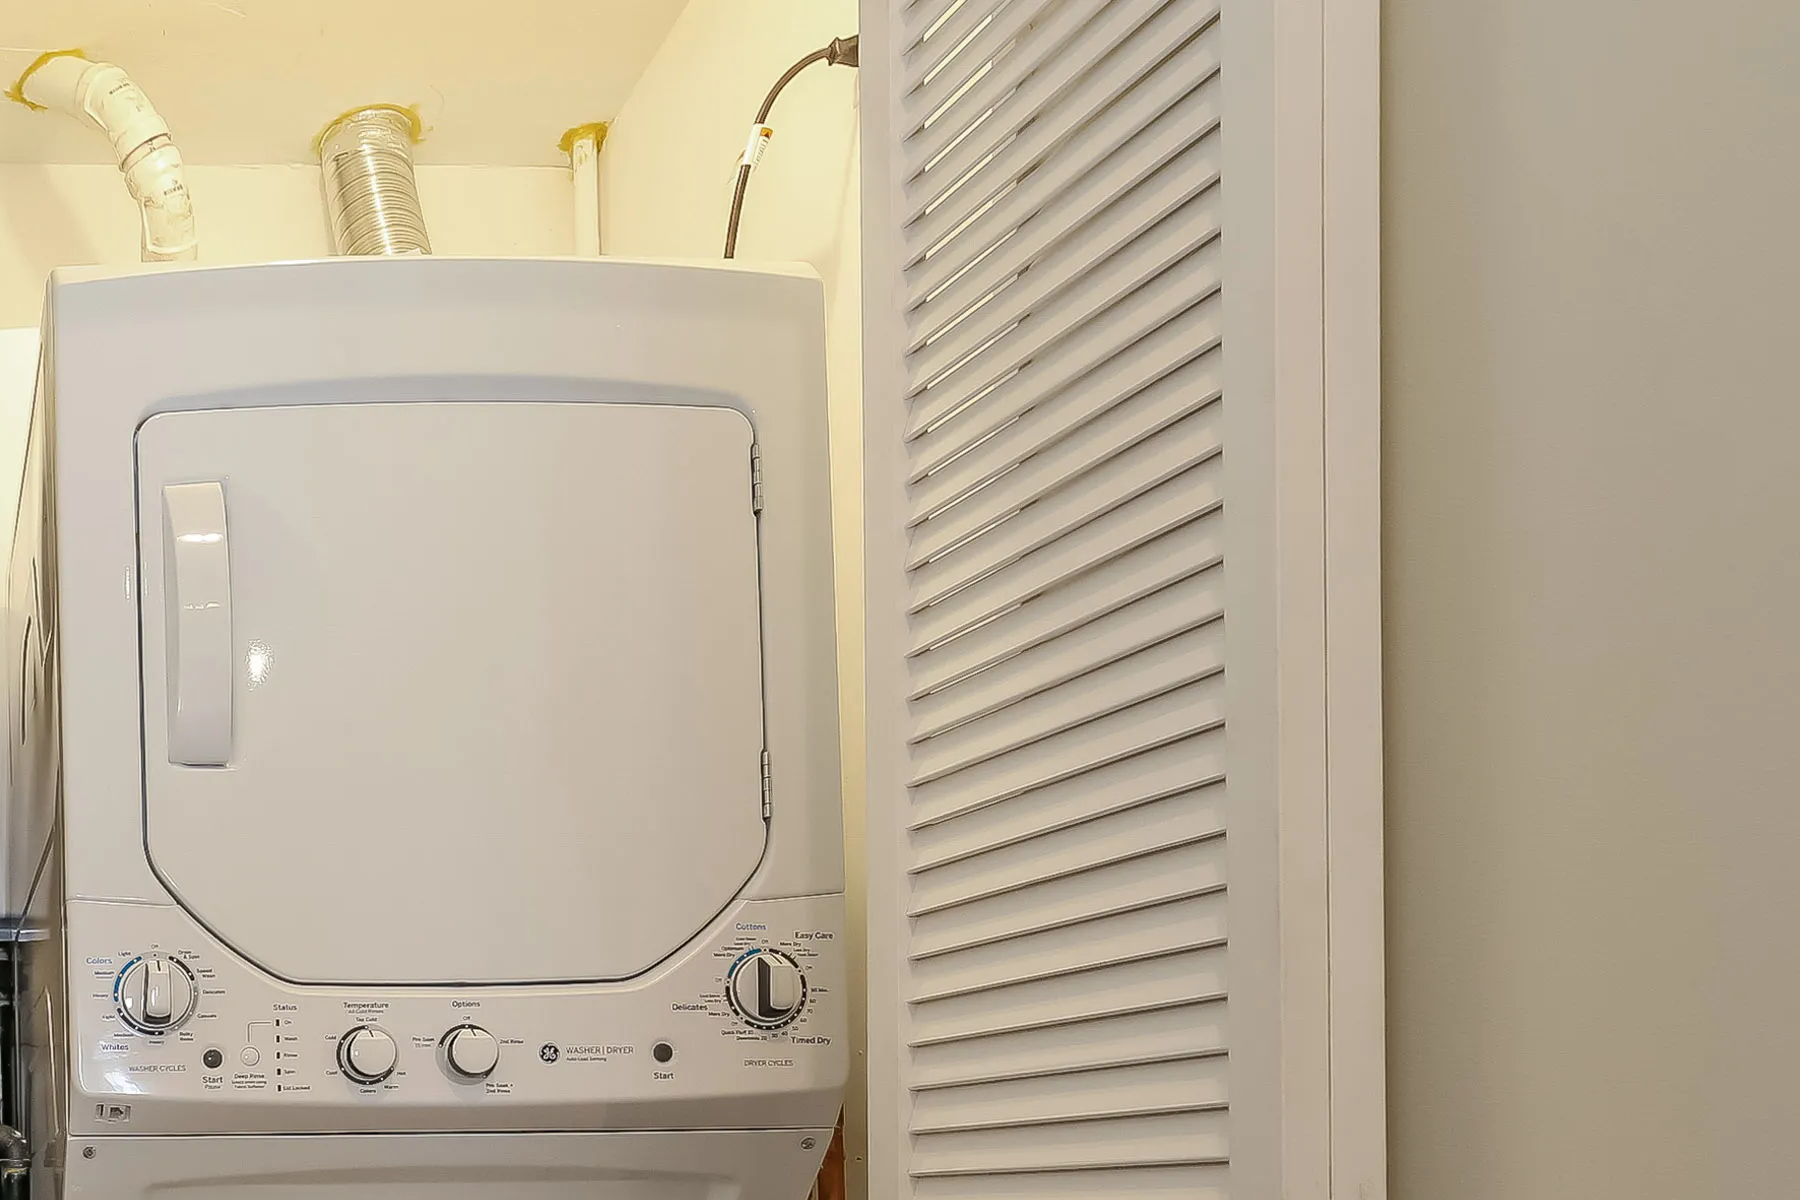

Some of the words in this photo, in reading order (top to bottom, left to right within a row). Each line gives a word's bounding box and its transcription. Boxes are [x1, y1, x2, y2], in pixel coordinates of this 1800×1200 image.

[735, 922, 767, 931] Cottons
[795, 931, 813, 940] Easy
[814, 931, 834, 939] Care
[86, 956, 113, 965] Colors
[272, 1003, 298, 1011] Status
[343, 1002, 389, 1010] Temperature
[452, 1001, 481, 1009] Options
[672, 1003, 708, 1012] Delicates
[791, 1036, 816, 1045] Timed
[816, 1036, 832, 1046] Dry
[101, 1043, 129, 1052] Whites
[566, 1046, 600, 1054] WASHER
[606, 1046, 634, 1054] DRYER
[128, 1065, 157, 1073] WASHER
[158, 1064, 187, 1072] CYCLES
[202, 1076, 224, 1085] Start
[653, 1072, 674, 1080] Start
